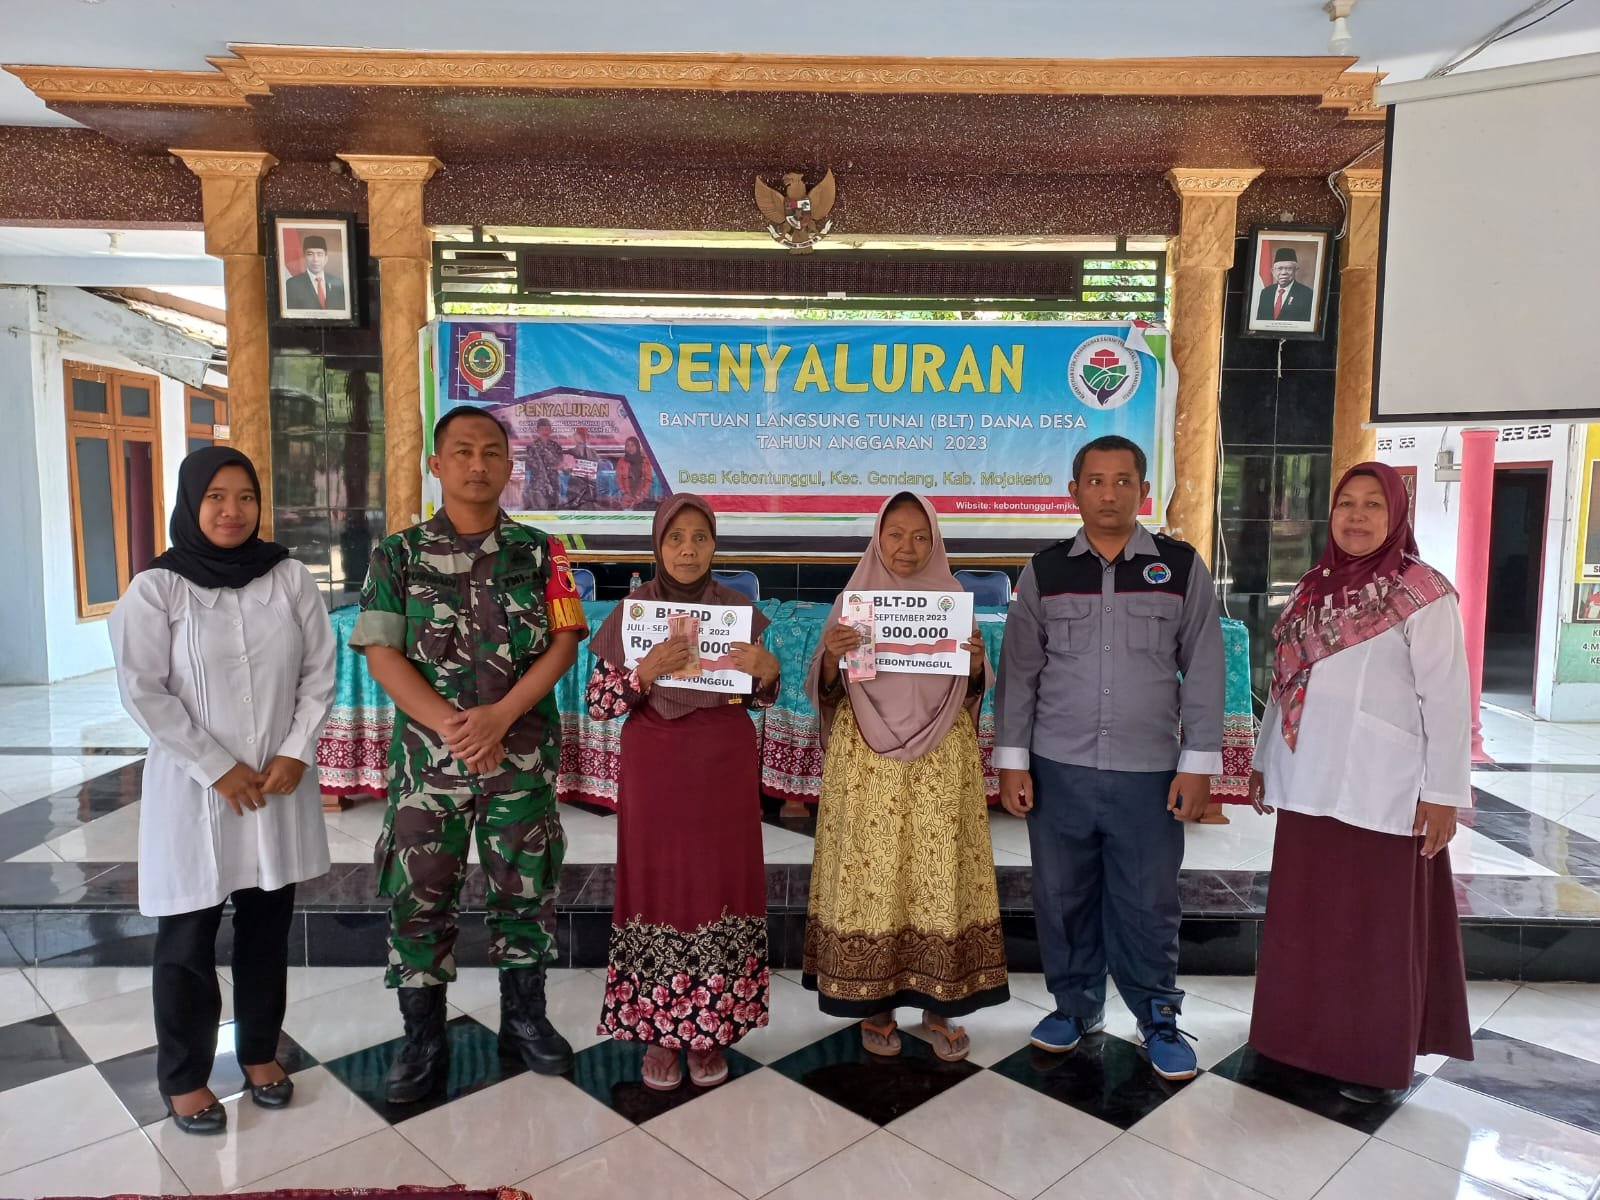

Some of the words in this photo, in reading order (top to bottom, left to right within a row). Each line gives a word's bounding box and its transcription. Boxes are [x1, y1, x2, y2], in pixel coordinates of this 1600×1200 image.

[637, 342, 1025, 394] PENYALURAN
[515, 403, 610, 418] PENYALURAN
[659, 412, 750, 428] BANTUAN
[755, 413, 861, 429] LANGSUNG
[865, 413, 925, 429] TUNAI
[929, 412, 975, 431] (BLT)
[980, 414, 1034, 430] DANA
[1039, 414, 1088, 430] DESA
[756, 434, 822, 450] TAHUN
[827, 435, 934, 451] ANGGARAN
[944, 435, 988, 451] 2023
[678, 469, 717, 485] Desa
[721, 470, 825, 487] Kebontunggul,
[830, 470, 862, 486] Kec.
[867, 471, 938, 488] Gondang,
[943, 471, 976, 486] Kab.
[981, 471, 1053, 489] Mojokerto
[955, 501, 991, 511] Wibsite:
[874, 597, 928, 608] BLT-DD
[874, 613, 925, 622] SEPTEMBER
[926, 614, 948, 622] 2023
[626, 623, 645, 631] JULI
[709, 628, 731, 636] 2023
[882, 626, 949, 639] 900.000
[630, 635, 653, 651] Rp
